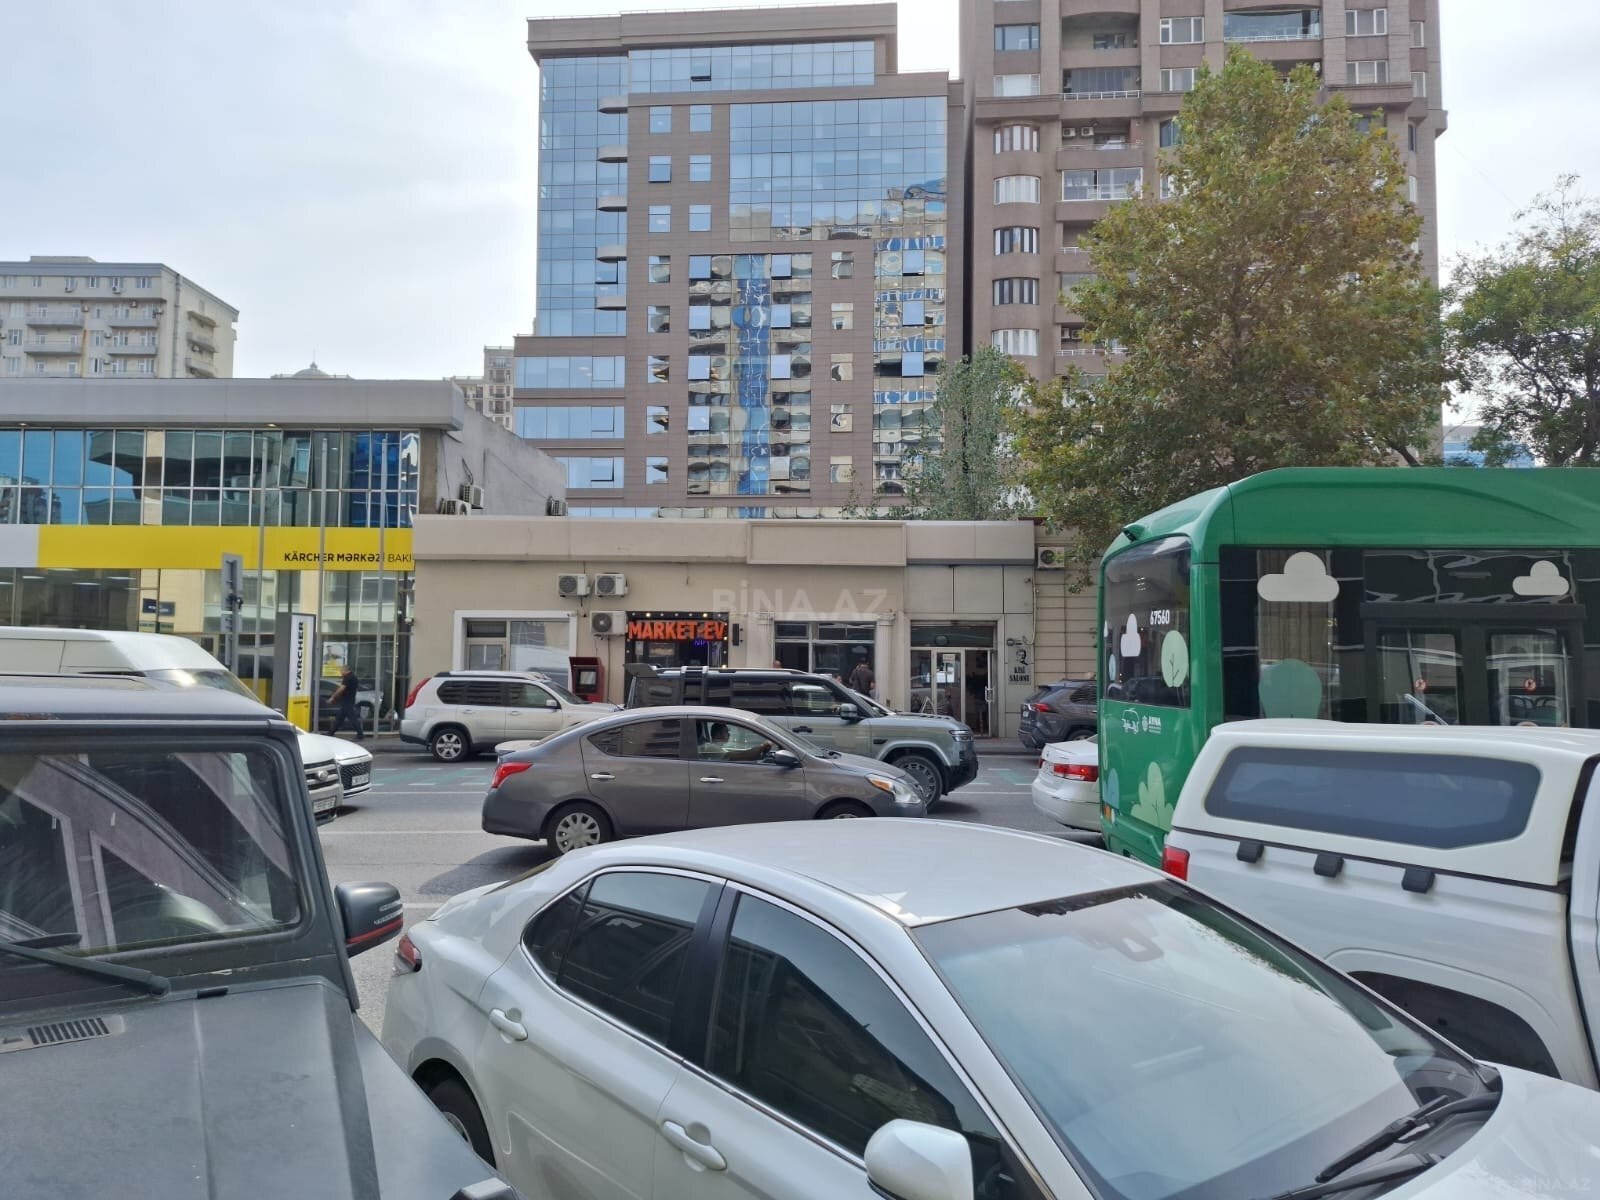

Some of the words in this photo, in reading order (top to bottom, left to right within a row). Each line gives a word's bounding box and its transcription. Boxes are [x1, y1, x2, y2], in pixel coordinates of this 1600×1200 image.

[284, 551, 335, 562] KÄRCHER
[387, 553, 412, 563] BAKI
[1150, 609, 1170, 625] 67560
[628, 621, 698, 640] MARKET
[704, 621, 725, 640] EV
